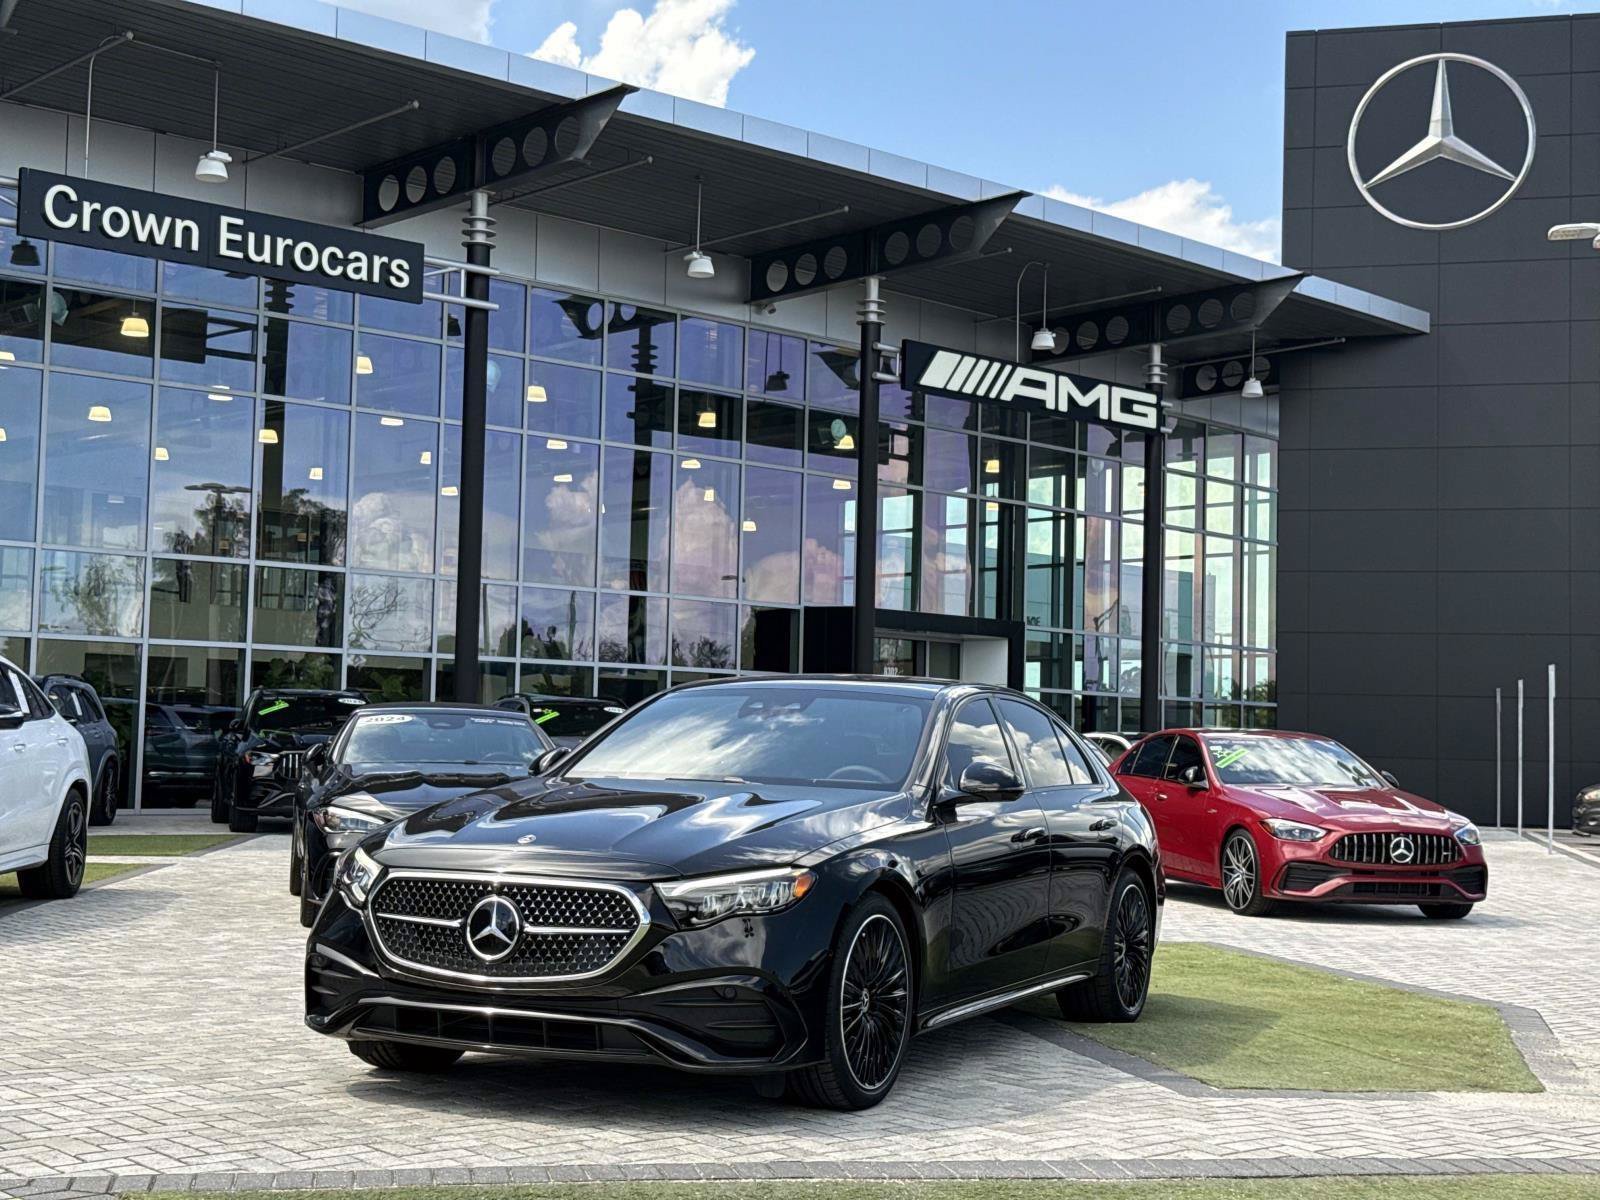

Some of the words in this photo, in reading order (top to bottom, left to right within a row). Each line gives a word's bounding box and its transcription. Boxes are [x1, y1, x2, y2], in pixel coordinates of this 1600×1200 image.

[44, 184, 199, 251] Crown
[218, 215, 411, 288] Eurocars
[1000, 366, 1157, 429] AMG
